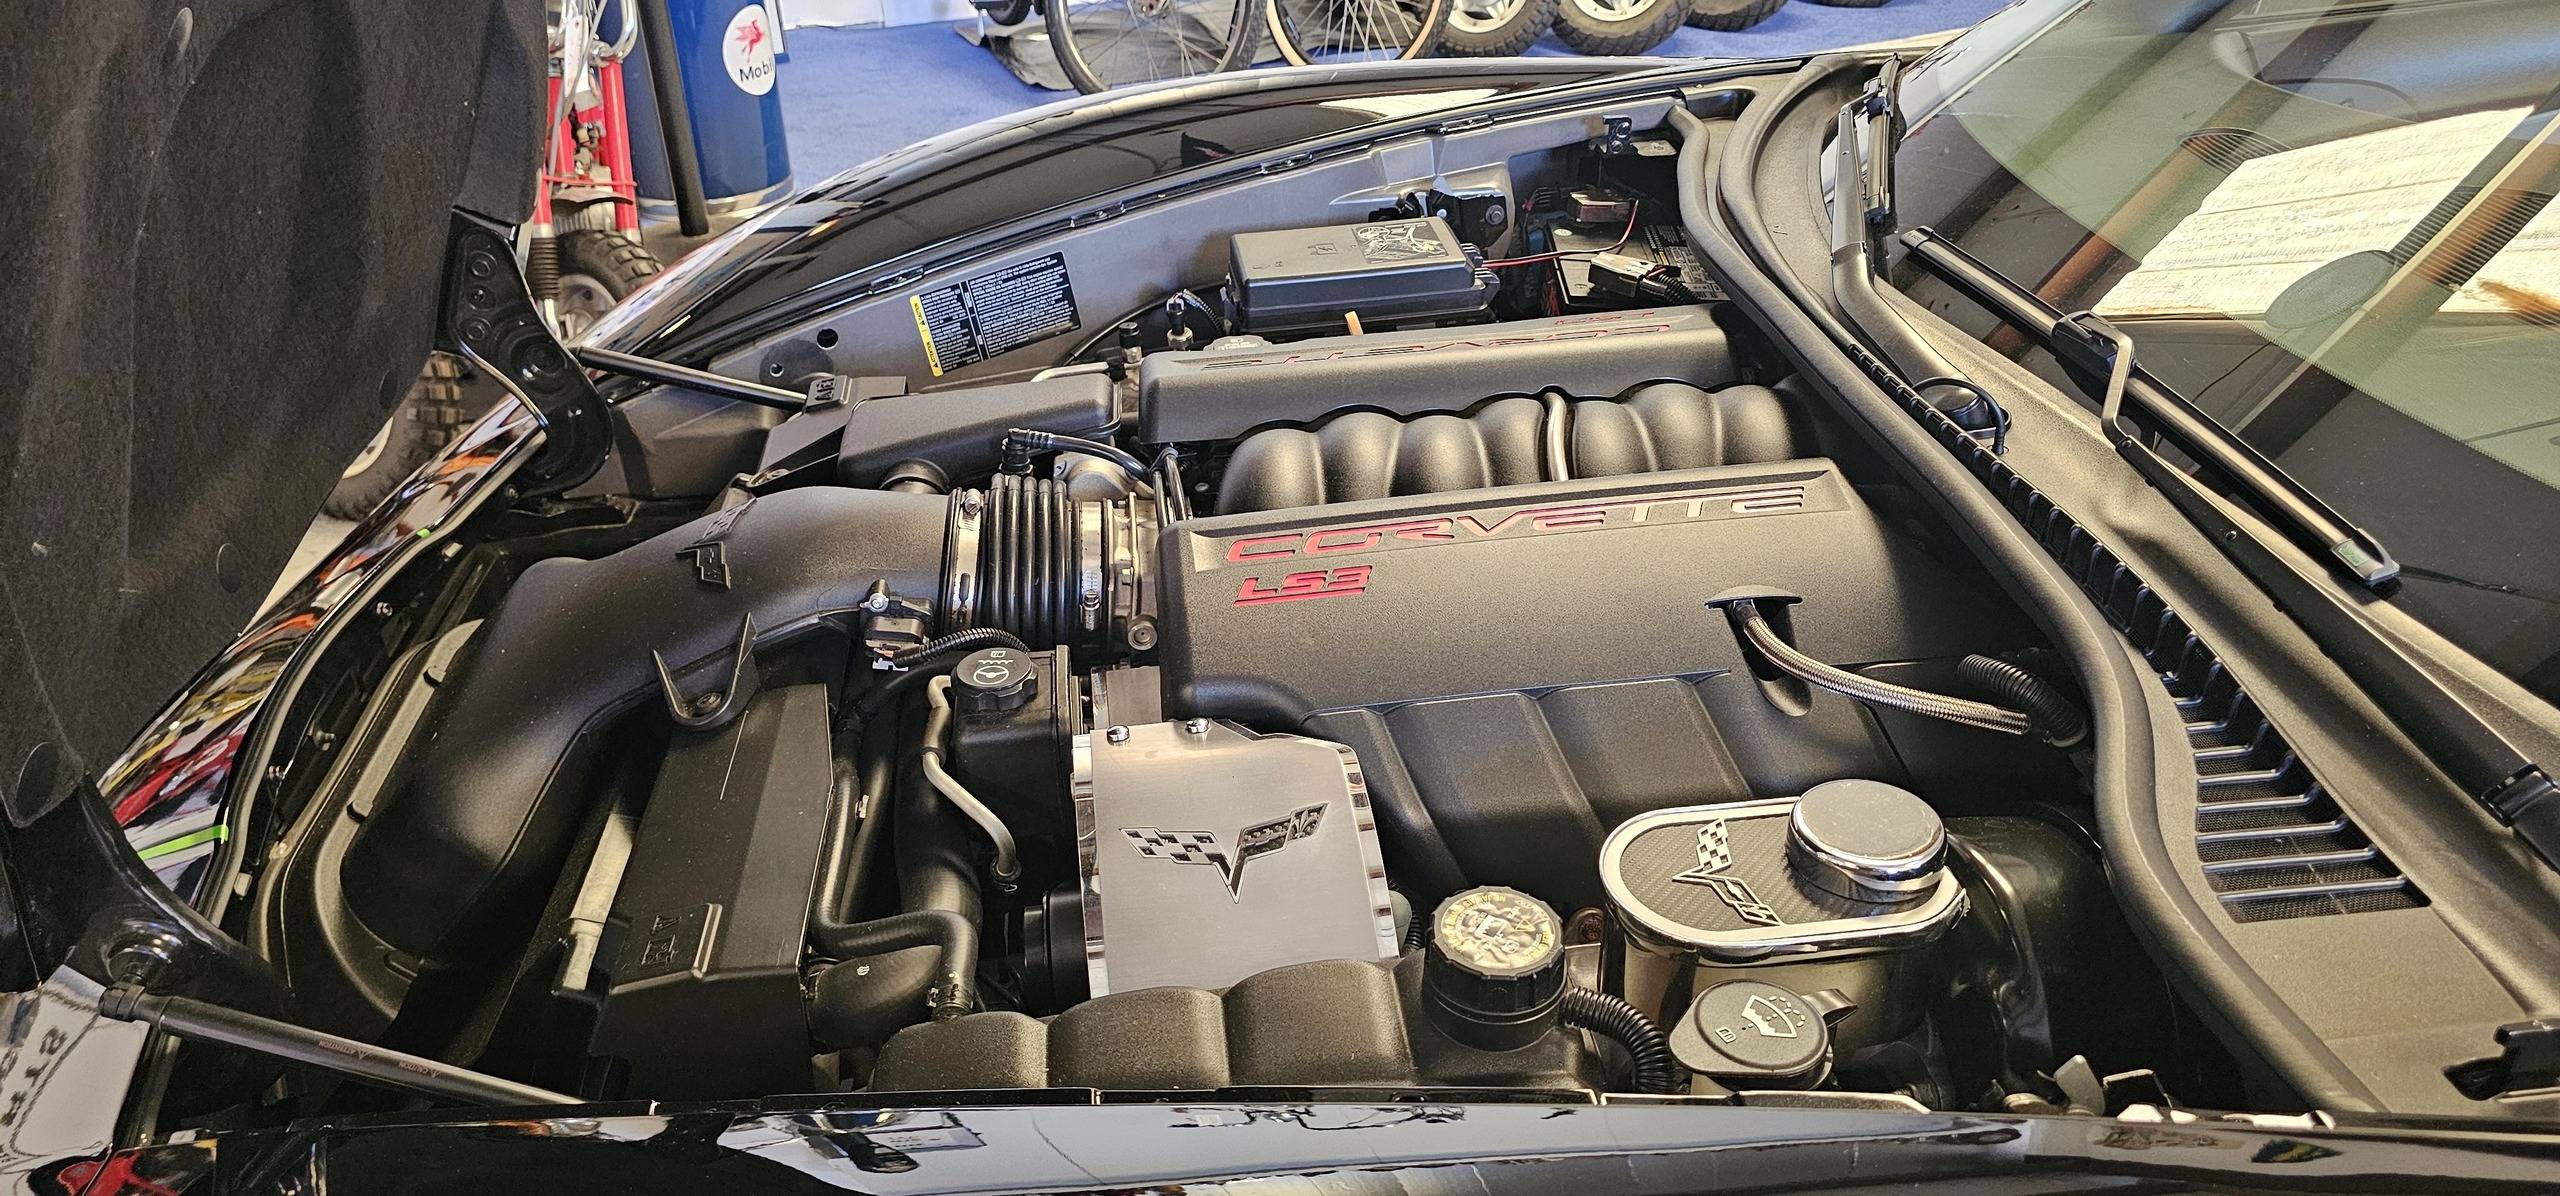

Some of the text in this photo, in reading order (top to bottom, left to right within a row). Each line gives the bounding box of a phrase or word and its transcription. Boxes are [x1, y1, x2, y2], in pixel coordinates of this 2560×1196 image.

[1225, 486, 1804, 562] CORVETTE
[1237, 565, 1373, 601] LS3
[318, 1039, 357, 1057] ATTENTION
[399, 1061, 430, 1076] CAUTION
